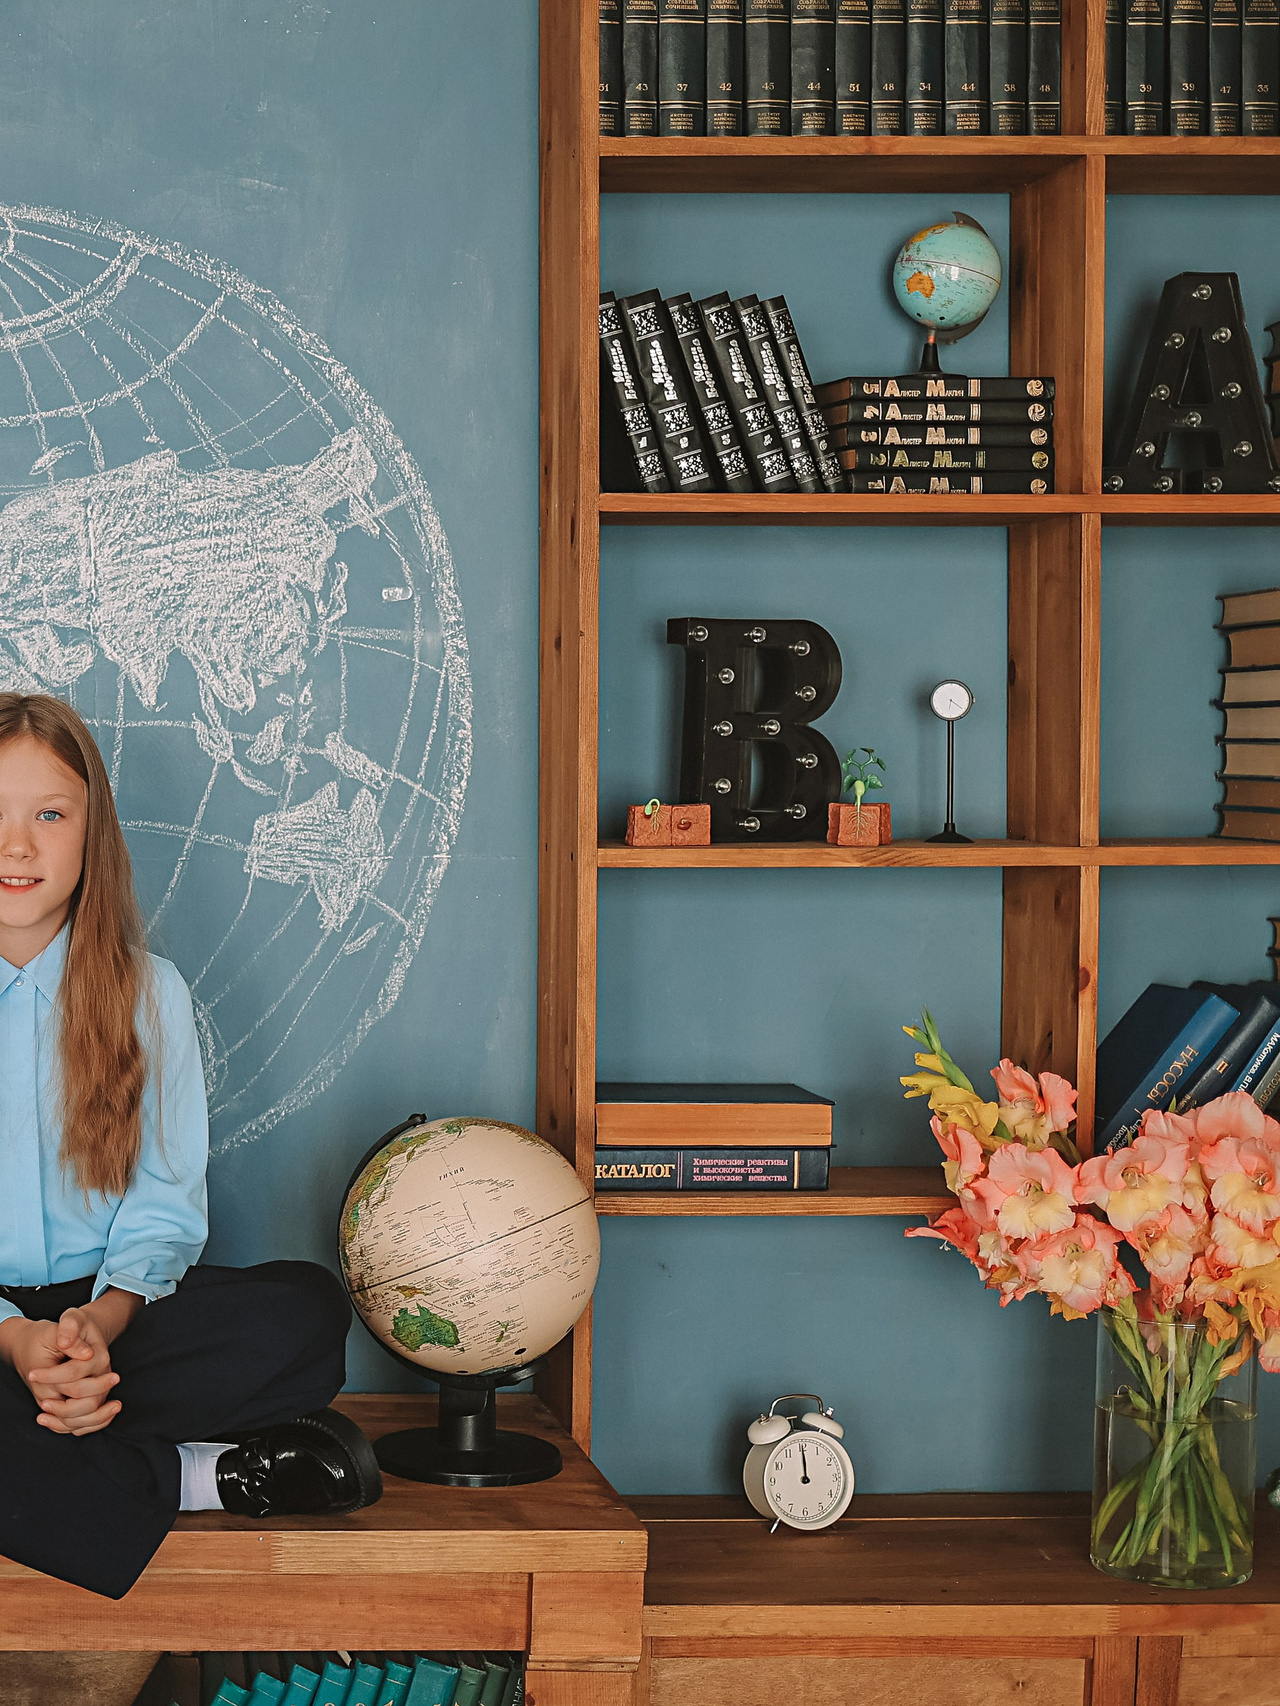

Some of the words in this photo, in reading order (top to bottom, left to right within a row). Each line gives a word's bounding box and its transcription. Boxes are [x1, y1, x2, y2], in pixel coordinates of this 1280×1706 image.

[635, 83, 649, 91] 43
[676, 83, 688, 92] 37
[720, 82, 732, 91] 42
[762, 82, 775, 91] 45
[807, 82, 822, 91] 44
[849, 83, 861, 92] 51
[882, 83, 895, 91] 48
[919, 83, 931, 91] 34
[961, 83, 976, 92] 44
[1003, 84, 1016, 92] 38
[1039, 84, 1051, 93] 48
[1139, 84, 1152, 93] 39
[1182, 83, 1195, 91] 39
[1220, 85, 1232, 94] 47
[1257, 84, 1269, 93] 35
[863, 382, 879, 394] 5
[863, 405, 879, 419] 4
[721, 434, 731, 445] 3
[860, 430, 878, 443] 3
[638, 436, 647, 448] 1
[819, 439, 828, 450] 6
[667, 617, 842, 843] B
[1146, 1044, 1199, 1104] НАСОСЫ
[693, 1158, 744, 1166] Химические
[747, 1159, 788, 1167] реактивы
[439, 1167, 465, 1181] ТИХИЙ
[595, 1164, 676, 1178] КАТАЛОГ
[748, 1175, 787, 1183] вещества
[785, 1449, 791, 1458] 11
[816, 1447, 819, 1455] 1
[775, 1462, 782, 1470] 10
[827, 1458, 832, 1466] 2
[770, 1477, 775, 1486] 9
[832, 1474, 837, 1482] 3
[776, 1494, 781, 1502] 8
[828, 1490, 832, 1498] 4
[789, 1504, 793, 1512] 7
[818, 1503, 823, 1511] 5
[803, 1508, 808, 1516] 6
